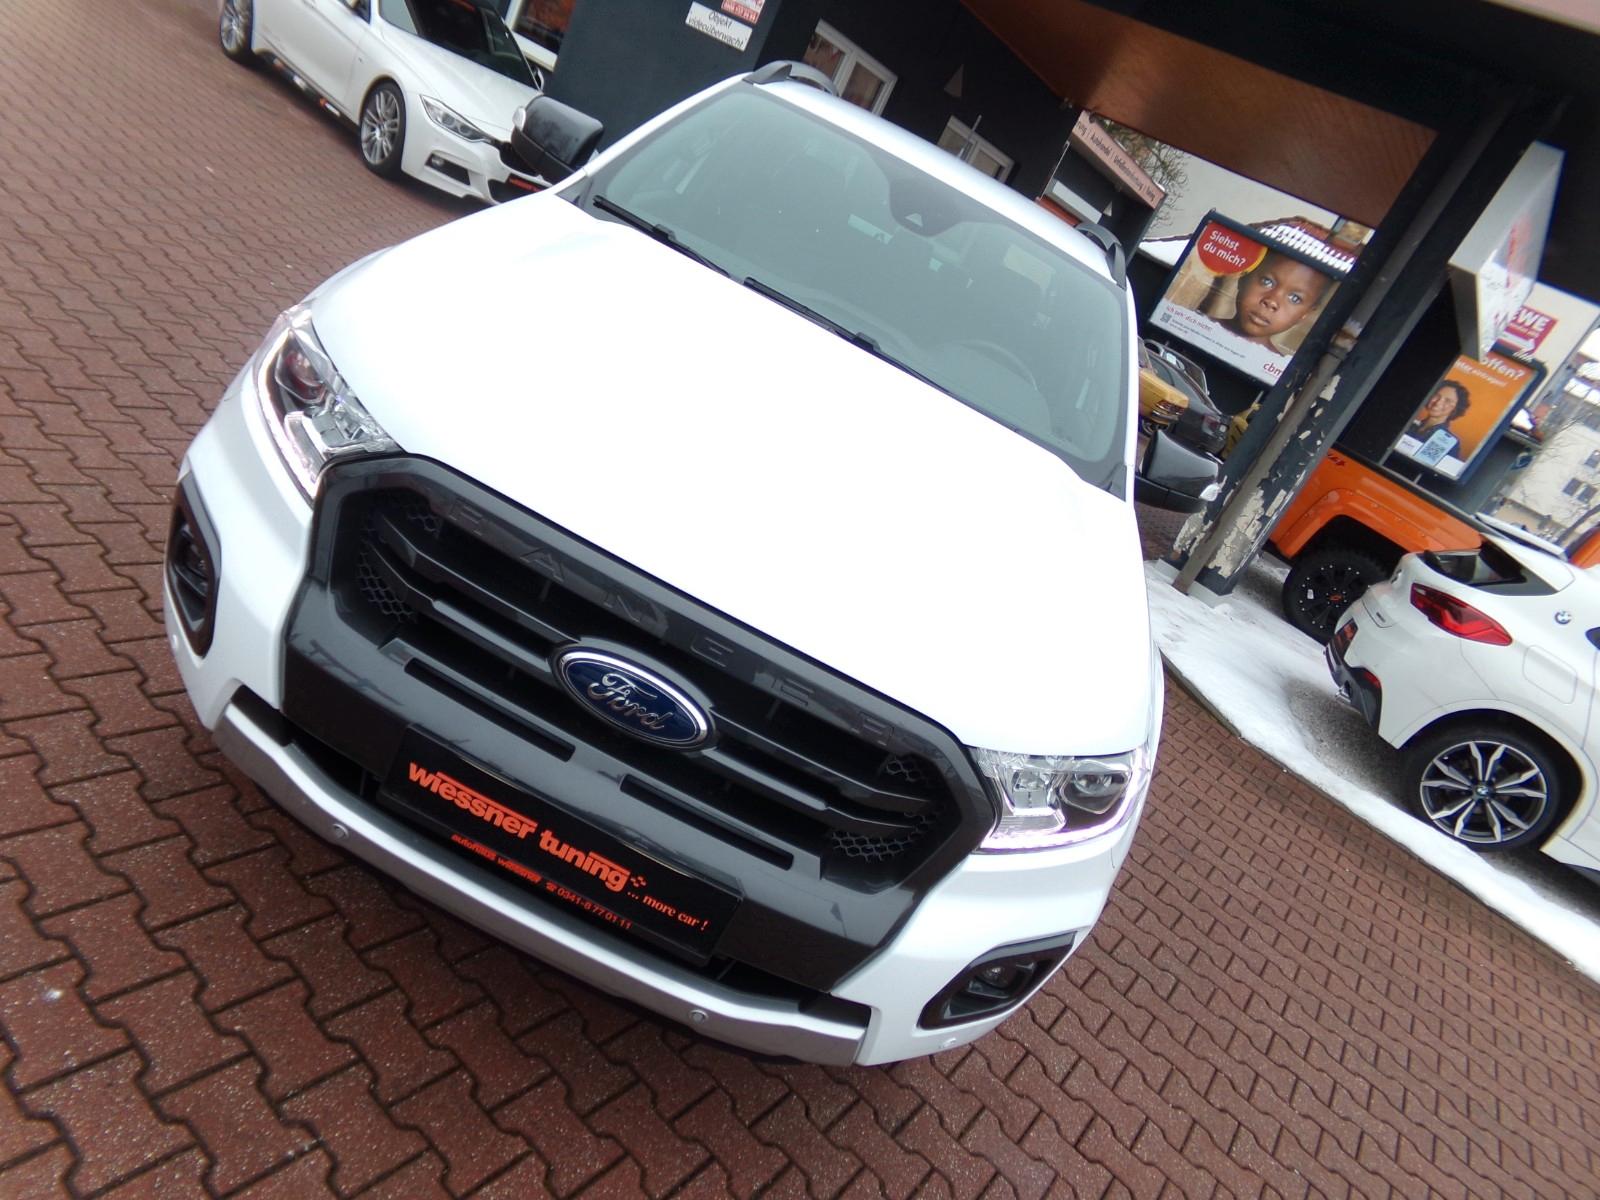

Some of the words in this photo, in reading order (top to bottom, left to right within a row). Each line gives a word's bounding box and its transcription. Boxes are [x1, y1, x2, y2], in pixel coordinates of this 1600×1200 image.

[708, 10, 733, 29] Objekt
[1203, 242, 1217, 254] du
[1216, 248, 1246, 267] mich?
[1209, 225, 1239, 251] Siehst
[448, 498, 896, 747] RANGER
[587, 672, 670, 731] Ford
[408, 762, 538, 839] wiessner
[540, 829, 632, 892] tuning
[642, 894, 677, 917] more
[677, 911, 699, 929] car
